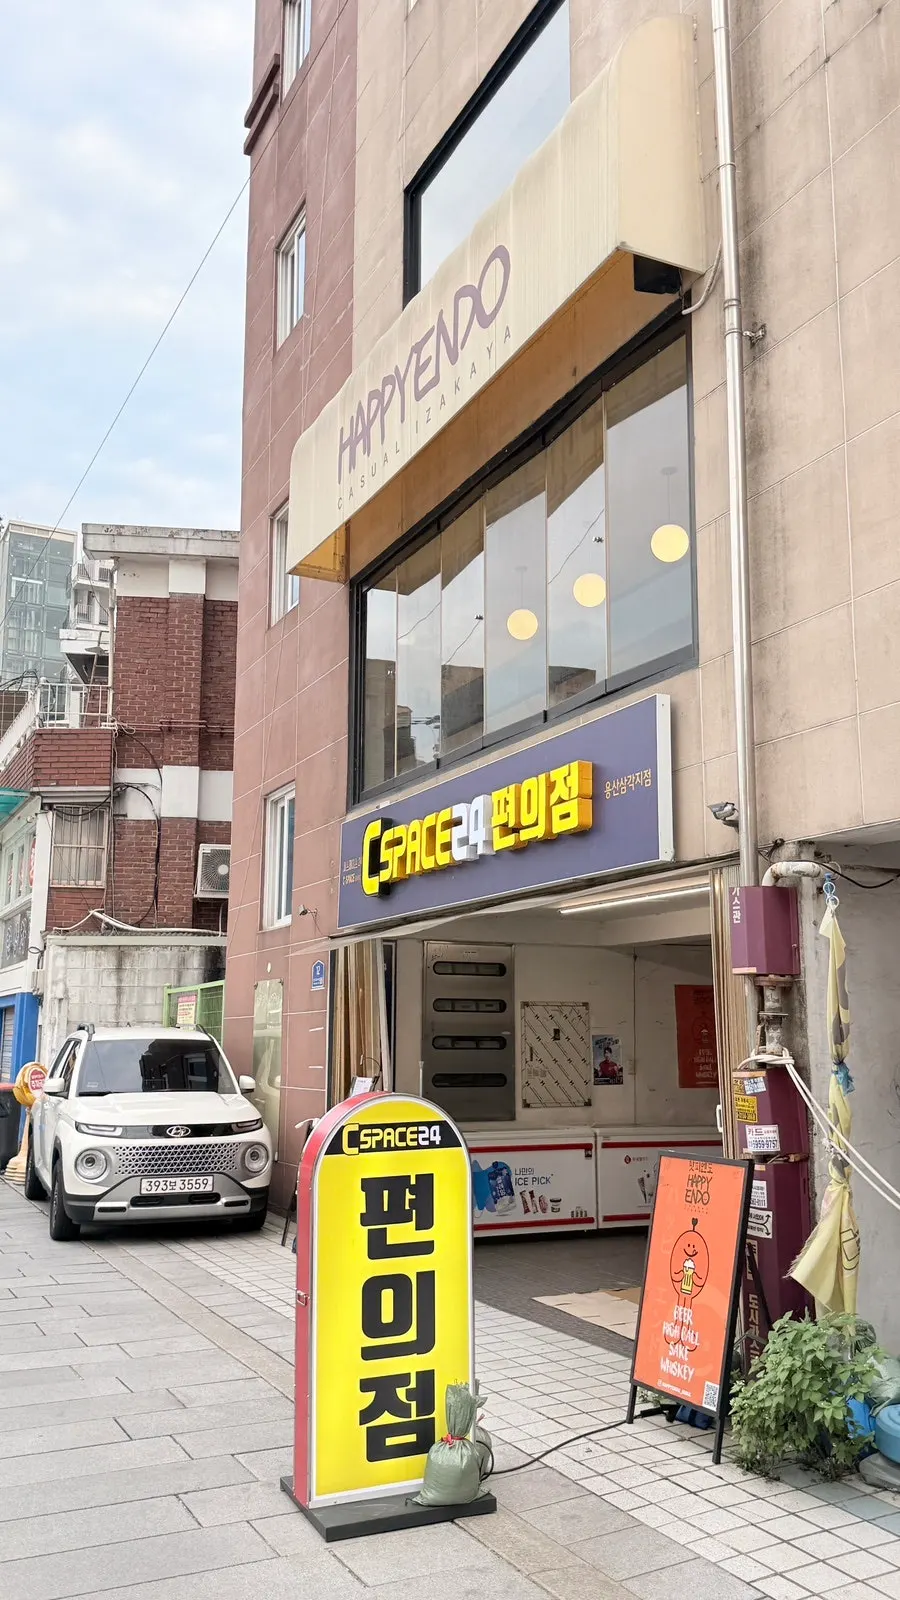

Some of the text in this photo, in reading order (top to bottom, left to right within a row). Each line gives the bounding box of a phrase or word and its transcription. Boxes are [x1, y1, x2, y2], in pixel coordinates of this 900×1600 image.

[337, 325, 511, 509] CASUAL IZAKAYA
[604, 768, 652, 799] 용산삼각지점
[491, 760, 593, 850] 편의점
[179, 1178, 209, 1191] 3559
[514, 1176, 529, 1187] ICE
[531, 1175, 551, 1186] PICK
[687, 1173, 713, 1192] HAPPY
[684, 1188, 710, 1206] ENDO
[359, 1173, 437, 1463] 편의점
[673, 1304, 693, 1326] BEER
[668, 1341, 690, 1361] SAKE
[660, 1356, 695, 1383] WHISKEY
